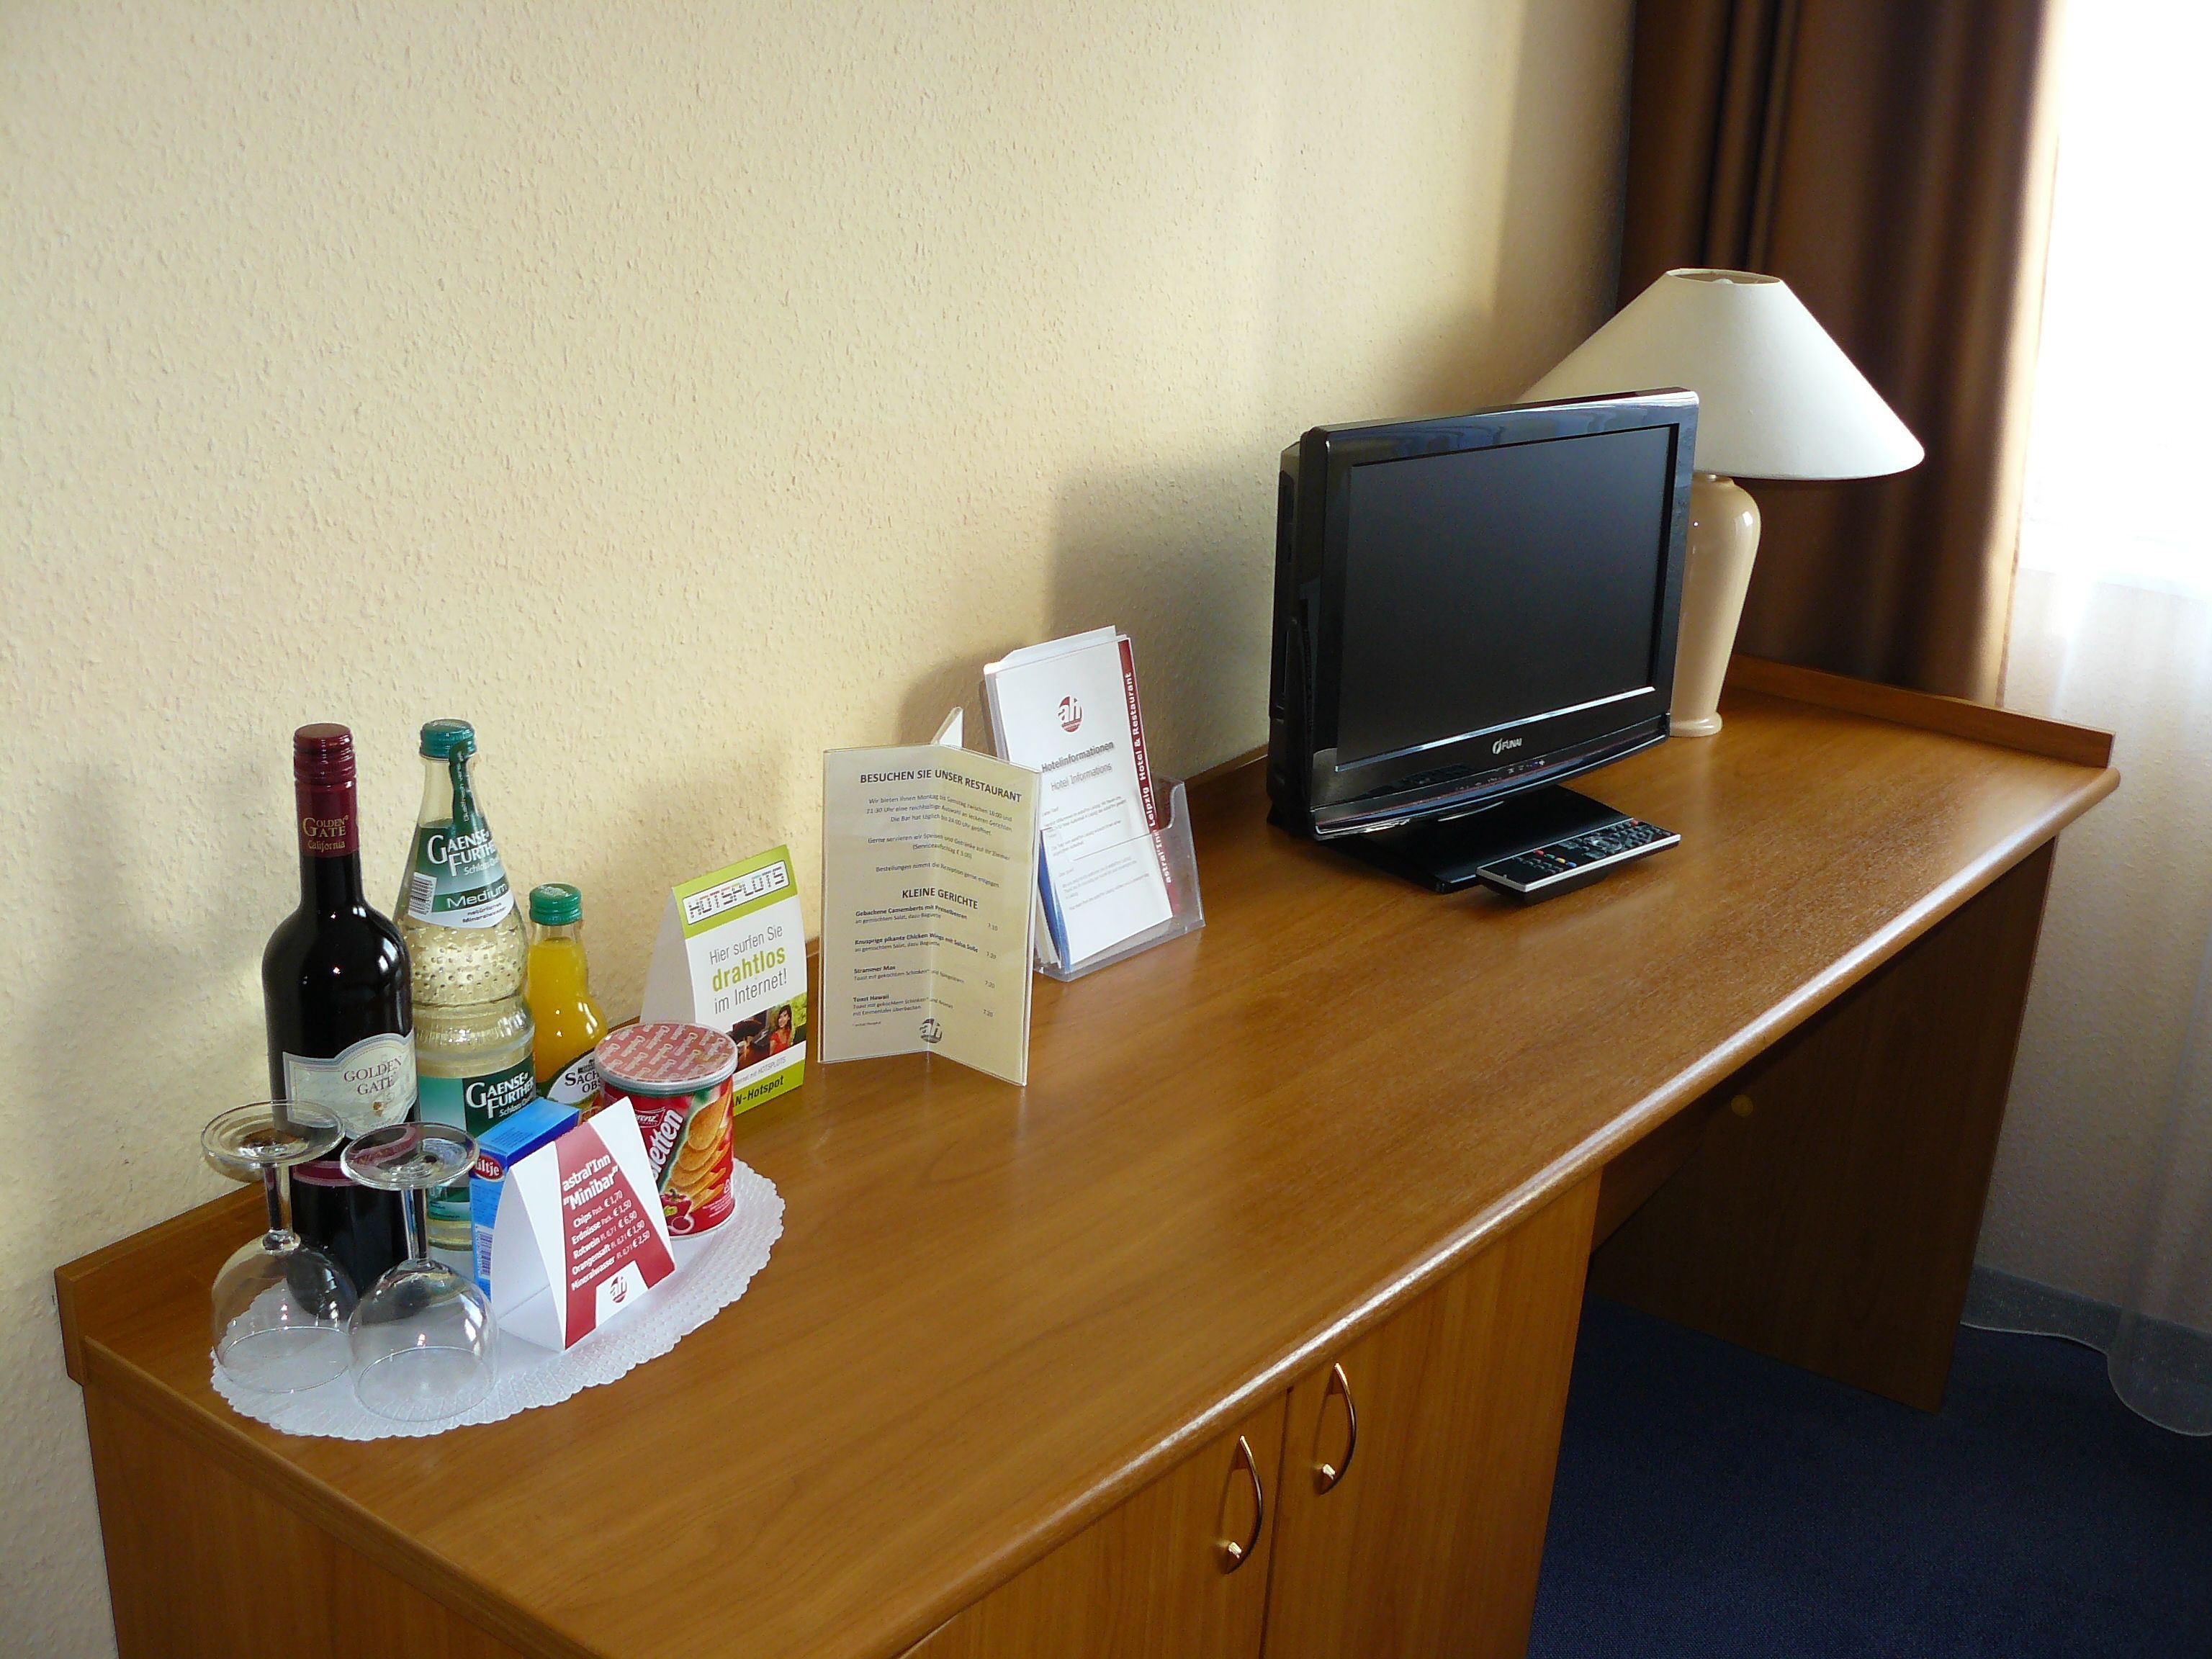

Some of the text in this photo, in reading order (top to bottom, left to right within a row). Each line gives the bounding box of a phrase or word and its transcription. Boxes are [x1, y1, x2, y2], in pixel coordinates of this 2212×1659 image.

[1125, 672, 1139, 735] Restaurant
[1041, 742, 1114, 773] Hotelinformationen
[1134, 738, 1141, 747] &
[1136, 750, 1146, 781] Hotel
[860, 769, 1022, 803] BESUCHEN SIE UNSER RESTAURANT
[1051, 778, 1069, 791] Hotel
[1143, 787, 1156, 827] Leipzig
[302, 817, 346, 832] GOLDEN
[302, 824, 346, 837] GATE
[308, 840, 346, 853] California
[449, 839, 497, 877] FURTHE
[446, 883, 508, 908] Medium
[902, 888, 978, 909] KLEINE GERICHTE
[709, 925, 783, 965] Hier surfen Sie
[712, 947, 786, 992] drahtlos
[714, 968, 787, 1015] im Internet!
[343, 1056, 402, 1082] GOLDEN
[357, 1075, 395, 1095] GATE
[565, 1071, 599, 1086] SACH
[582, 1079, 600, 1092] OB
[734, 1074, 784, 1106] N-Hotspot
[562, 1154, 611, 1191] astral'Inn
[571, 1222, 601, 1245] Erdnüsse
[613, 1208, 619, 1217] €
[619, 1199, 632, 1213] 1,50
[573, 1213, 592, 1228] Chips
[604, 1198, 610, 1208] €
[610, 1190, 623, 1205] 1,70
[572, 1237, 601, 1259] Rotwein
[618, 1218, 624, 1228] €
[624, 1210, 637, 1224] 6,90
[572, 1244, 611, 1275] Orangensaft
[626, 1228, 632, 1237] €
[632, 1220, 645, 1233] 1,90
[571, 1256, 615, 1291] Mineralwasser
[632, 1239, 639, 1249] €
[638, 1230, 650, 1244] 2,50
